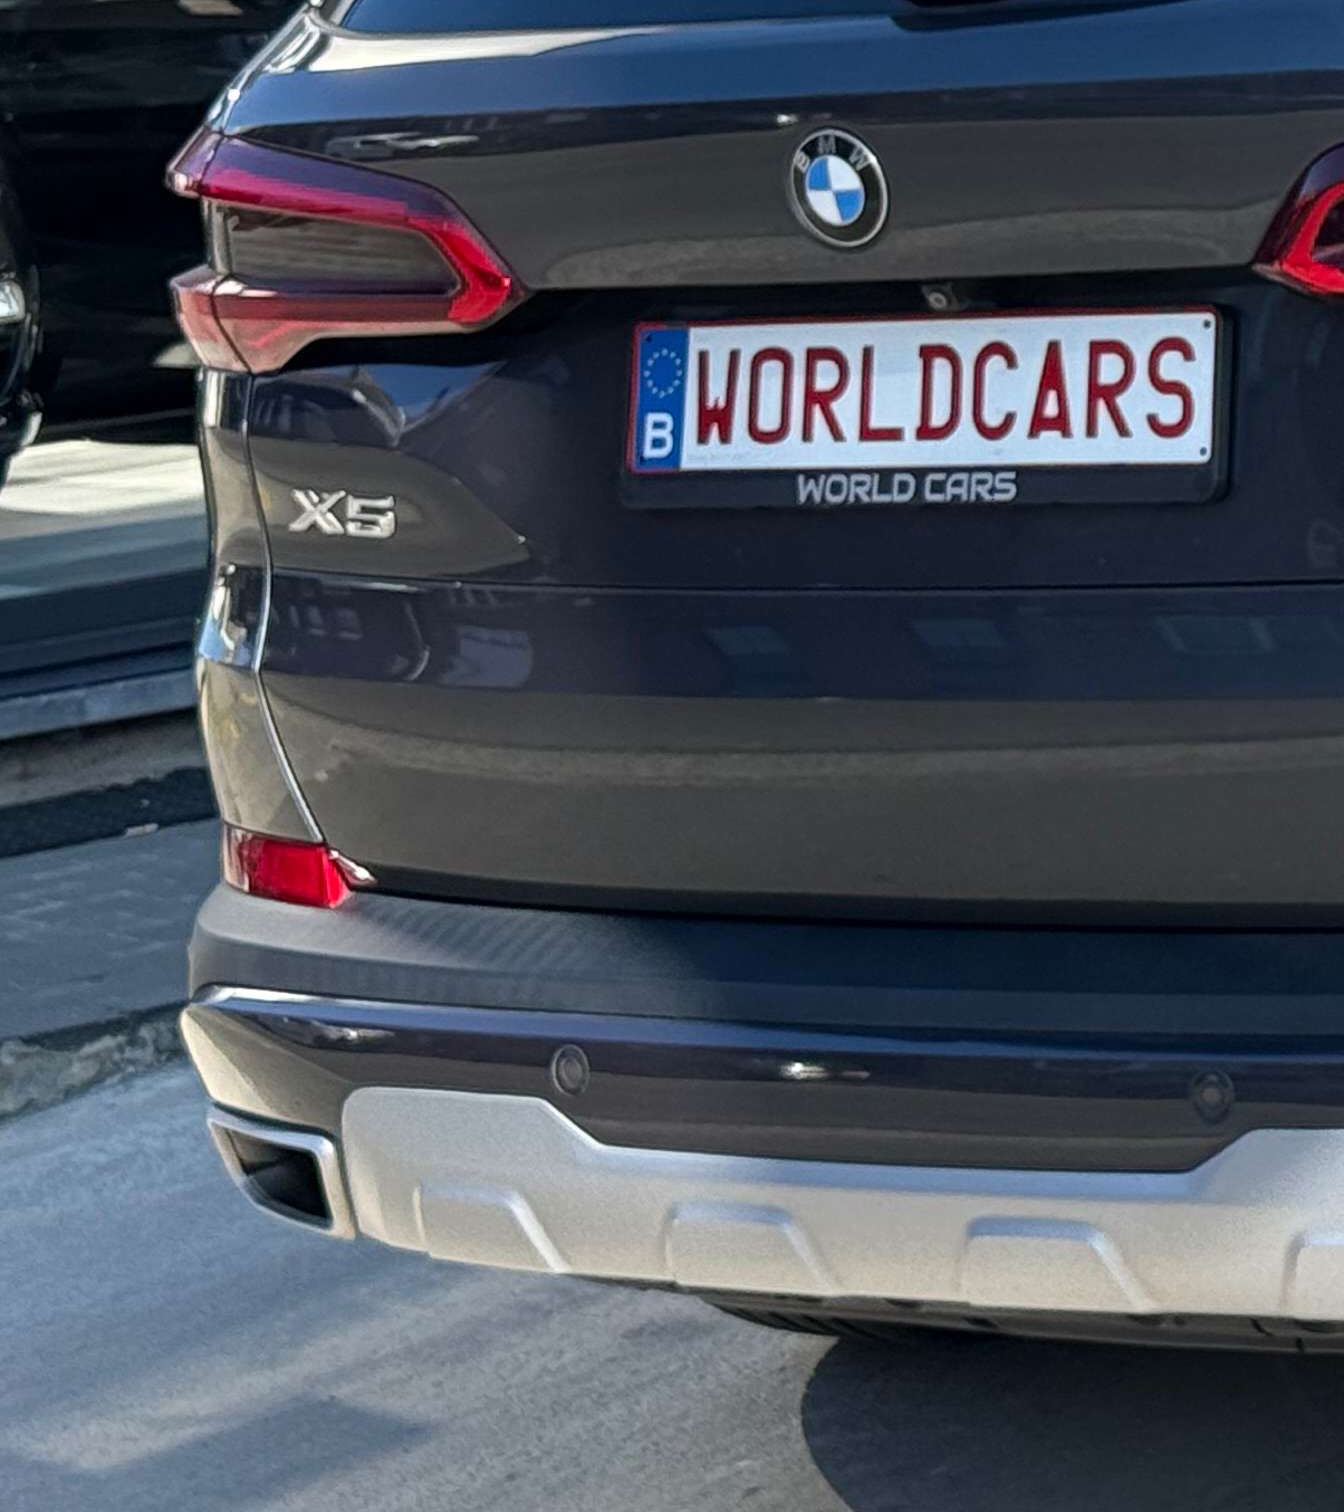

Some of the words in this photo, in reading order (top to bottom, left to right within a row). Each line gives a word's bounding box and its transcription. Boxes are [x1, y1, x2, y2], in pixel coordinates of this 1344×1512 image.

[642, 412, 675, 459] B
[696, 336, 1197, 445] WORLDCARS
[797, 471, 915, 505] WORLD
[923, 470, 1018, 504] CARS
[288, 488, 396, 538] X5
